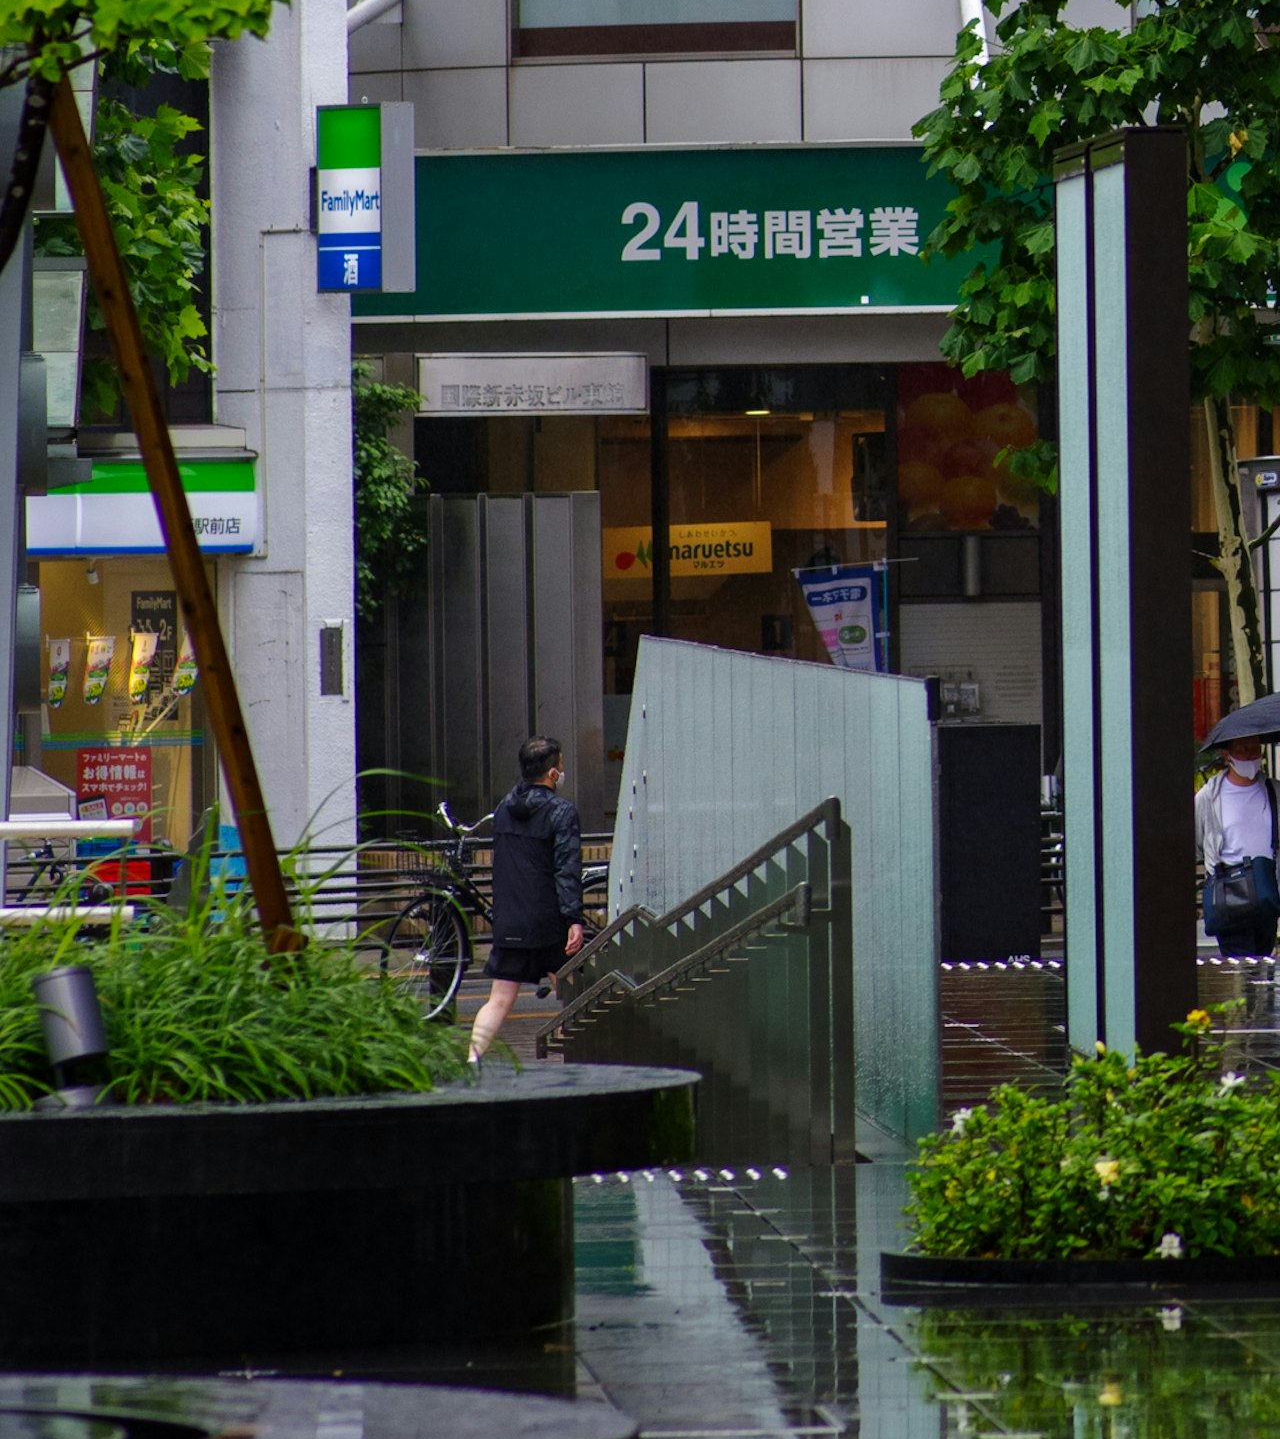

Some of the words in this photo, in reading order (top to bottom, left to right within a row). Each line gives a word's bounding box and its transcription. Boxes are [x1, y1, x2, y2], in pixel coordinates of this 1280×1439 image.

[321, 190, 380, 217] FamilyMart
[620, 200, 920, 262] 24時間営業
[343, 253, 359, 286] 酒
[192, 517, 241, 535] 駅前店
[82, 752, 147, 763] ファミリーマートの
[82, 764, 146, 781] お得情報は
